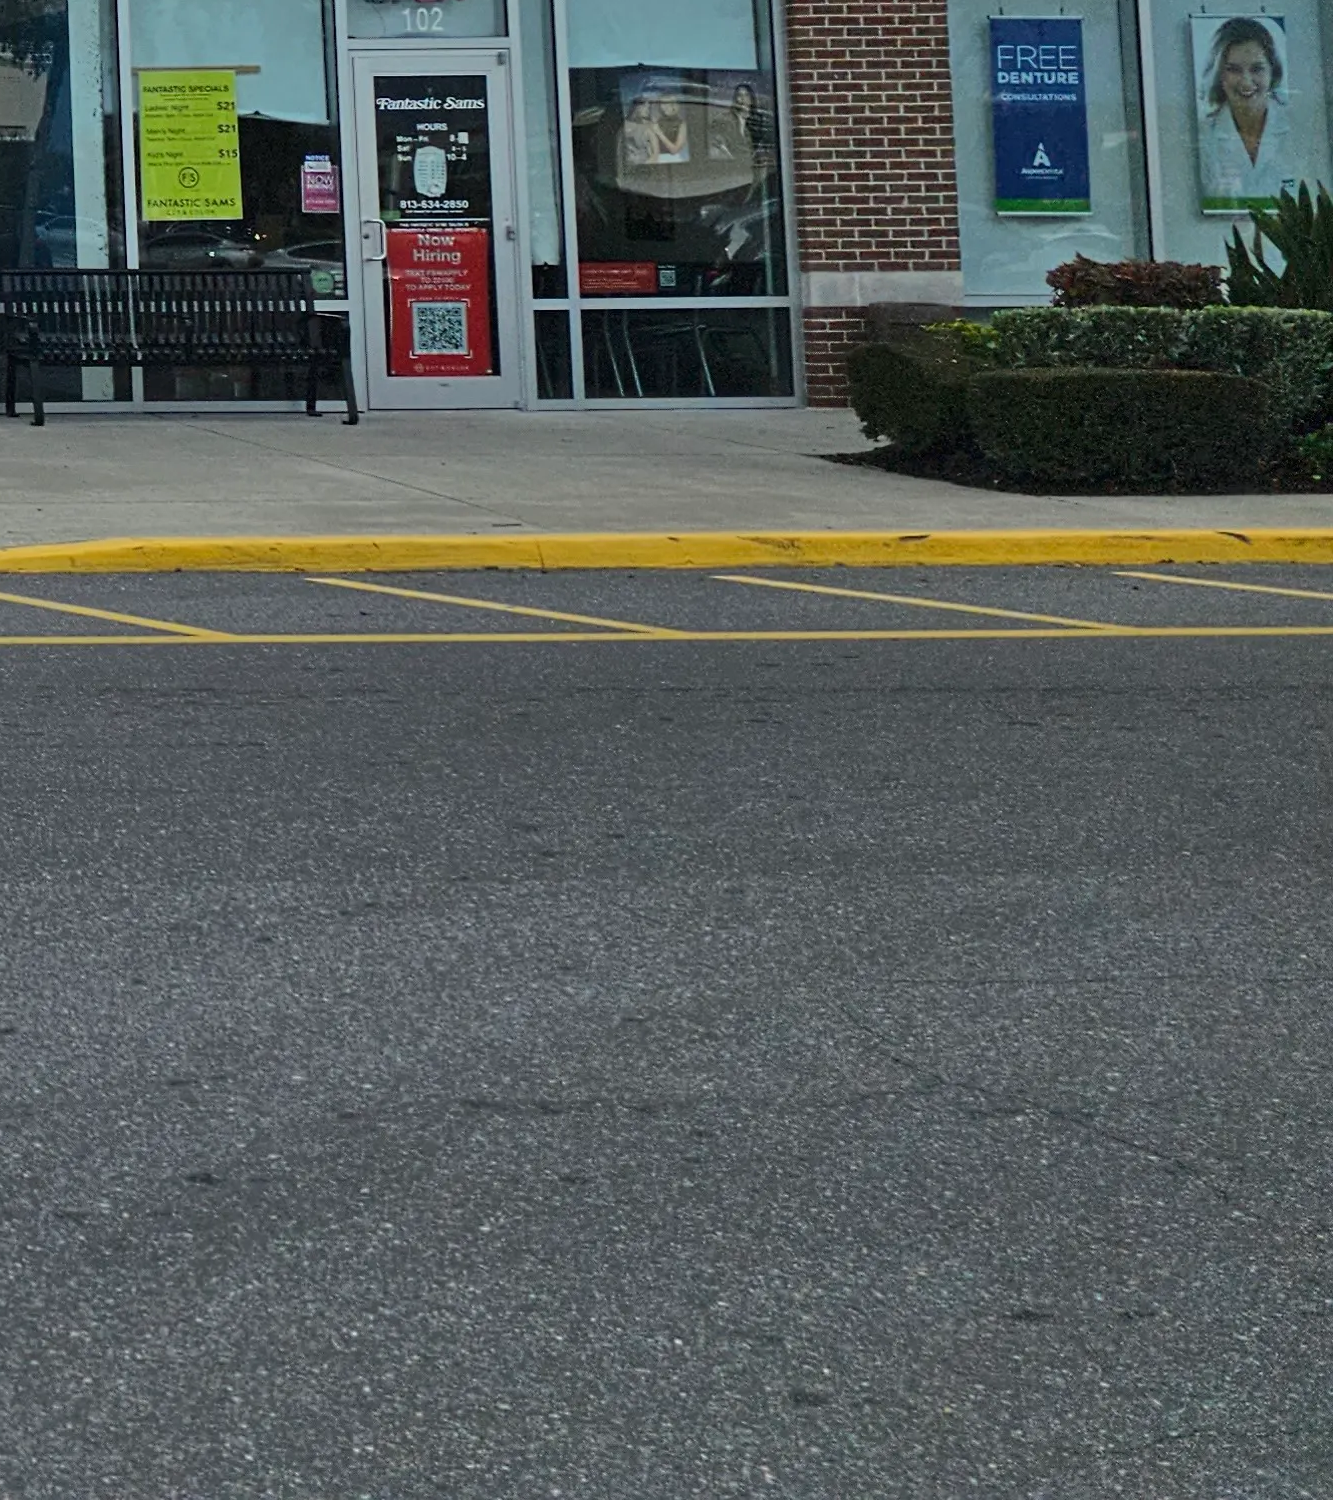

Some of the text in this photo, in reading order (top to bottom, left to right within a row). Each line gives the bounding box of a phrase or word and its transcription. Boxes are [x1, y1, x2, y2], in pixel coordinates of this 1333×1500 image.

[401, 7, 444, 31] 102
[997, 45, 1078, 70] FREE
[997, 71, 1079, 85] DENTURE
[142, 85, 230, 93] FANTASTIC SPECIALS
[1000, 92, 1077, 101] CONSULTATIONS
[216, 101, 236, 111] $21
[376, 97, 485, 110] Fantastic Sams
[217, 124, 237, 133] $21
[416, 123, 449, 131] HOURS
[218, 149, 238, 158] $15
[147, 198, 236, 208] FANTASTIC SAMS
[417, 234, 456, 246] Now
[412, 249, 462, 265] Hiring
